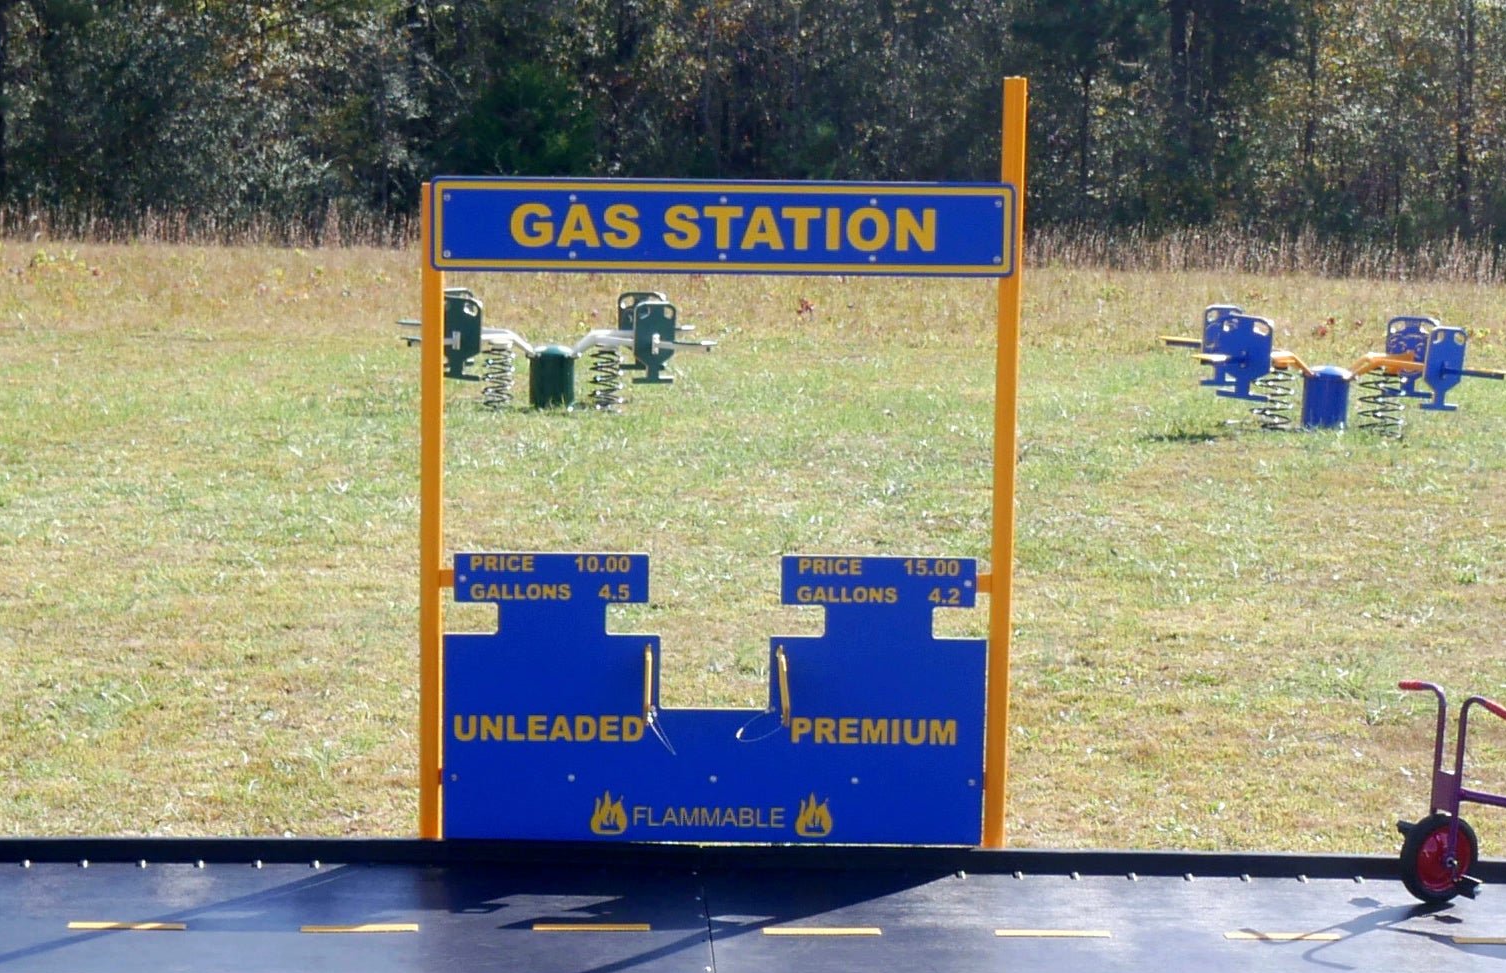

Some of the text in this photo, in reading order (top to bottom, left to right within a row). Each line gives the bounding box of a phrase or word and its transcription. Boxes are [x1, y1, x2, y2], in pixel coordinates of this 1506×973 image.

[510, 203, 936, 252] GAS STATION
[470, 556, 631, 572] PRICE 10.00
[798, 559, 960, 577] PRICE 15.00
[470, 583, 630, 600] GALLONS 4.5
[797, 586, 960, 604] GALLONS 4.2
[454, 714, 645, 741] UNLEADED
[791, 718, 957, 745] PREMIUM
[632, 806, 786, 828] FLAMMABLE
